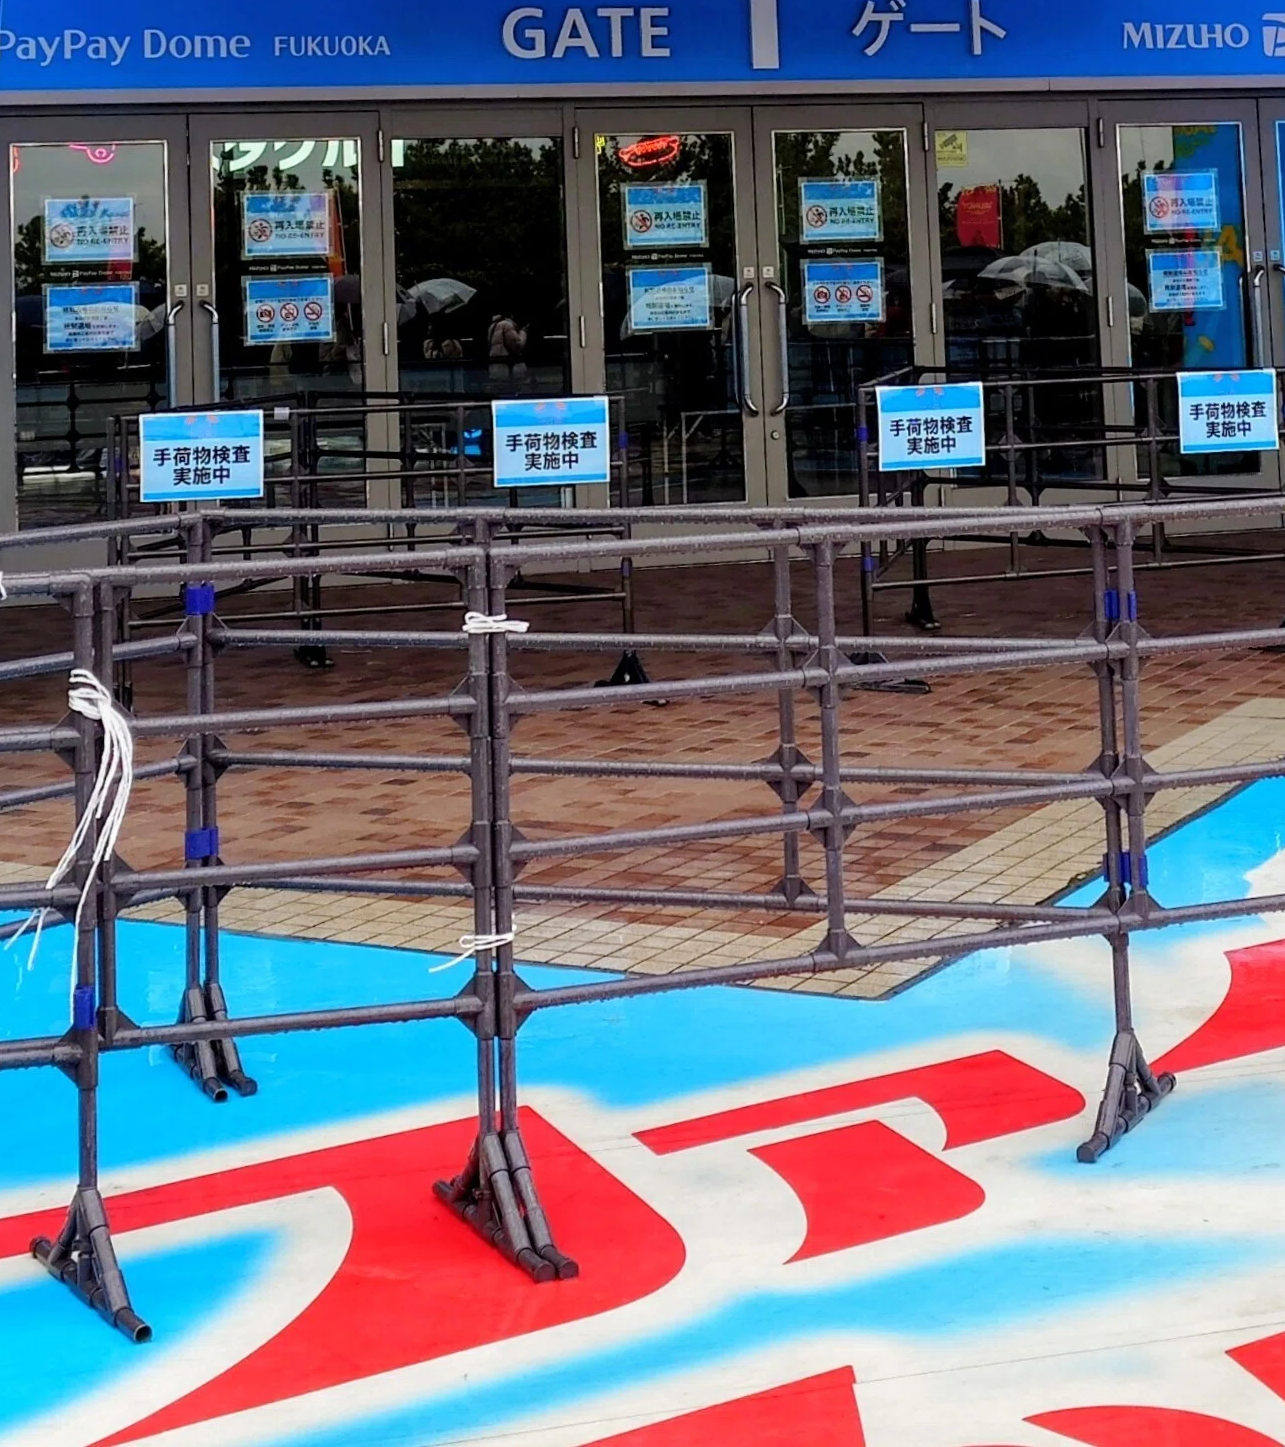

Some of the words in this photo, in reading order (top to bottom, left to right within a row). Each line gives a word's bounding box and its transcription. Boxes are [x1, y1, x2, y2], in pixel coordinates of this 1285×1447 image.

[144, 29, 251, 59] Dome
[274, 35, 391, 57] FUKUOKA
[502, 7, 671, 60] GATE
[1122, 21, 1249, 50] MIZUHO
[1189, 401, 1266, 421] 手荷物検査
[890, 416, 973, 437] 手荷物検査
[1206, 419, 1251, 438] 実施中
[505, 431, 598, 452] 手荷物検査
[907, 436, 956, 455] 実施中
[153, 445, 250, 466] 手荷物検査
[525, 451, 579, 471] 実施中
[173, 466, 230, 486] 実施中
